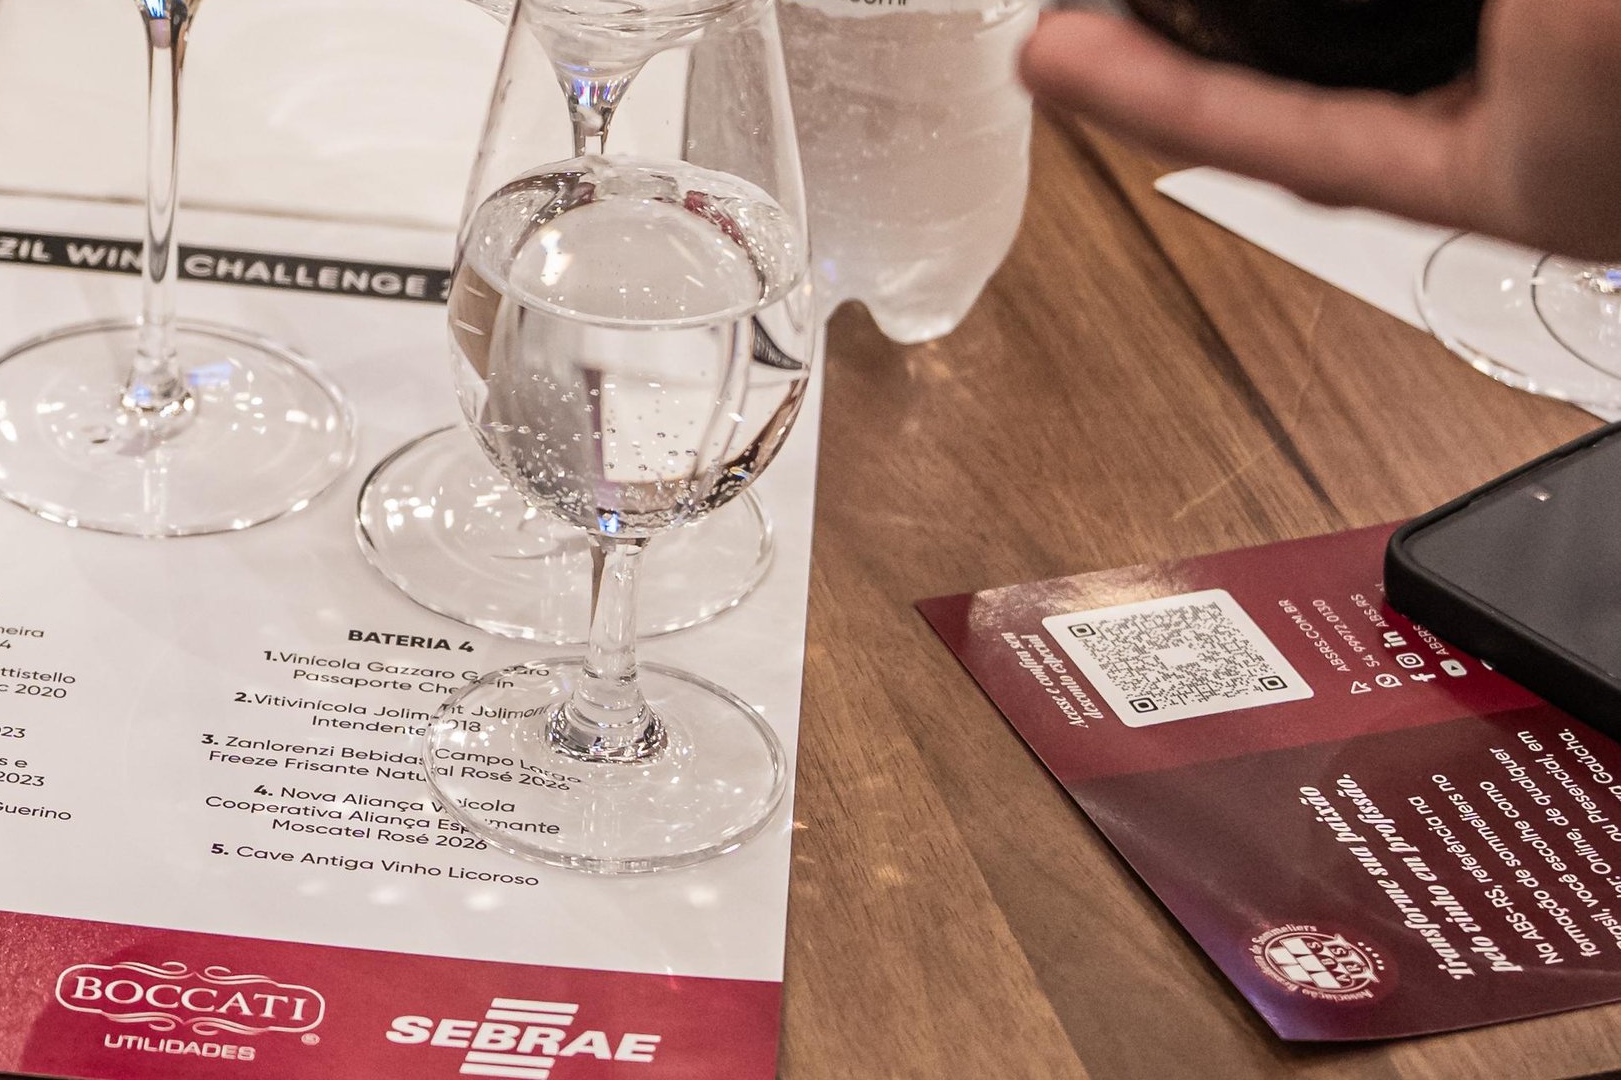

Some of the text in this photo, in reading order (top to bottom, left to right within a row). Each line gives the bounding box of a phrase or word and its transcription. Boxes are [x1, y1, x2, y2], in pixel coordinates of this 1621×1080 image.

[66, 242, 144, 271] WIN
[183, 254, 427, 297] CHALLENGE
[348, 630, 474, 652] BATERIA 4
[1278, 599, 1351, 673] ABSRS.COM.BR
[293, 669, 412, 691] Passaporte
[367, 662, 455, 679] Gazzaro
[1362, 654, 1380, 668] 54
[14, 684, 67, 698] 2020
[312, 715, 426, 737] Intendente
[1517, 730, 1544, 752] em
[14, 760, 27, 768] e
[209, 750, 571, 792] Freeze Frisante Rosé 2026
[225, 736, 335, 757] Zanlorenzi
[435, 747, 514, 766] Campo
[1558, 728, 1614, 784] Gaúcha.
[281, 787, 424, 813] Nova Aliança
[1535, 753, 1610, 823] Presencial,
[206, 796, 430, 830] Cooperativa Aliança
[1489, 748, 1612, 874] Online, de qualquer
[272, 818, 488, 850] Moscatel Rosé 2026
[1479, 781, 1599, 908] você escolhe como
[237, 846, 539, 886] Cave Antiga Vinho Licoroso
[1299, 786, 1477, 980] Transforme sua paixão
[1336, 773, 1524, 972] pelo vinho em profissão.
[1407, 796, 1564, 965] Na ABS-RS, referência na
[1431, 774, 1601, 957] formação de sommeliers no
[71, 976, 308, 1021] BOCCATI
[104, 1033, 256, 1061] UTILIDADES
[385, 1015, 662, 1063] SEBRAE
